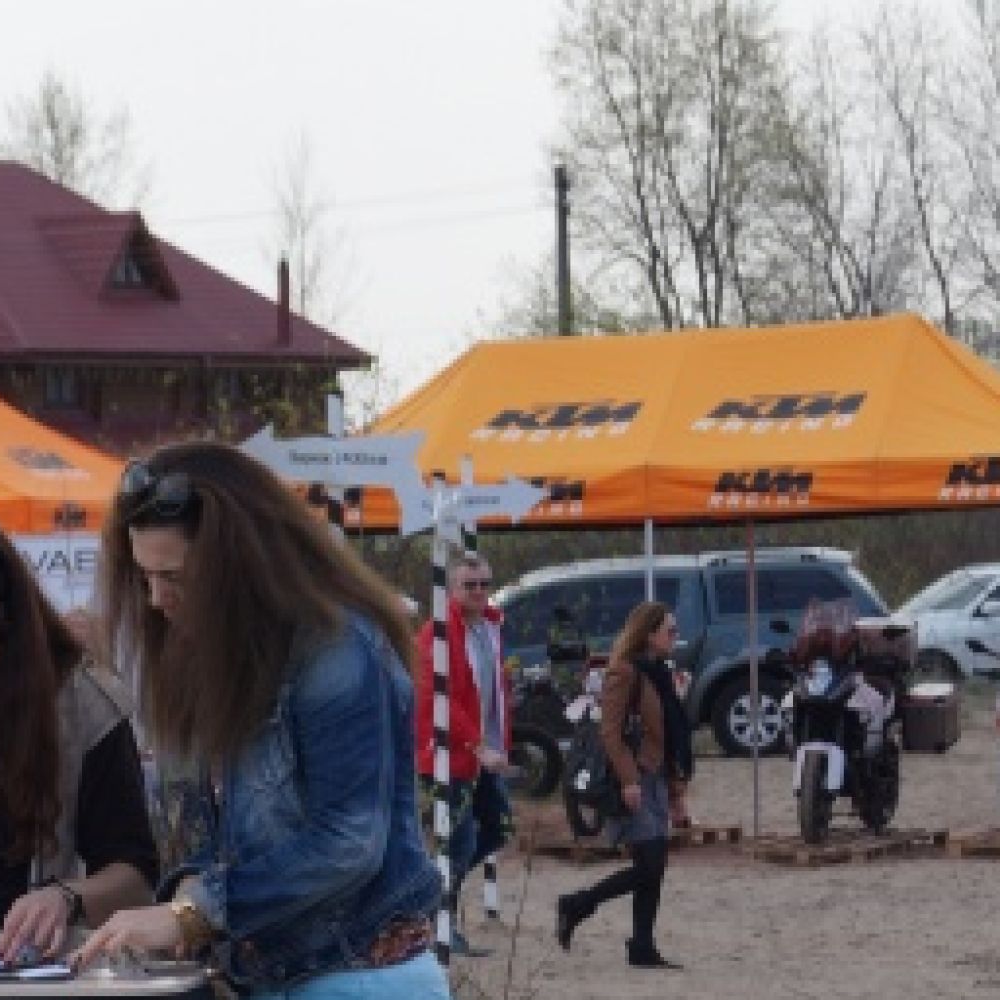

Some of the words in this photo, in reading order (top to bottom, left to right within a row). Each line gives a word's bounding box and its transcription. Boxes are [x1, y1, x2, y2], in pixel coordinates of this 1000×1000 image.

[488, 402, 643, 430] KTM
[704, 393, 866, 421] KTM
[714, 468, 813, 492] KTM
[945, 456, 1000, 485] KT
